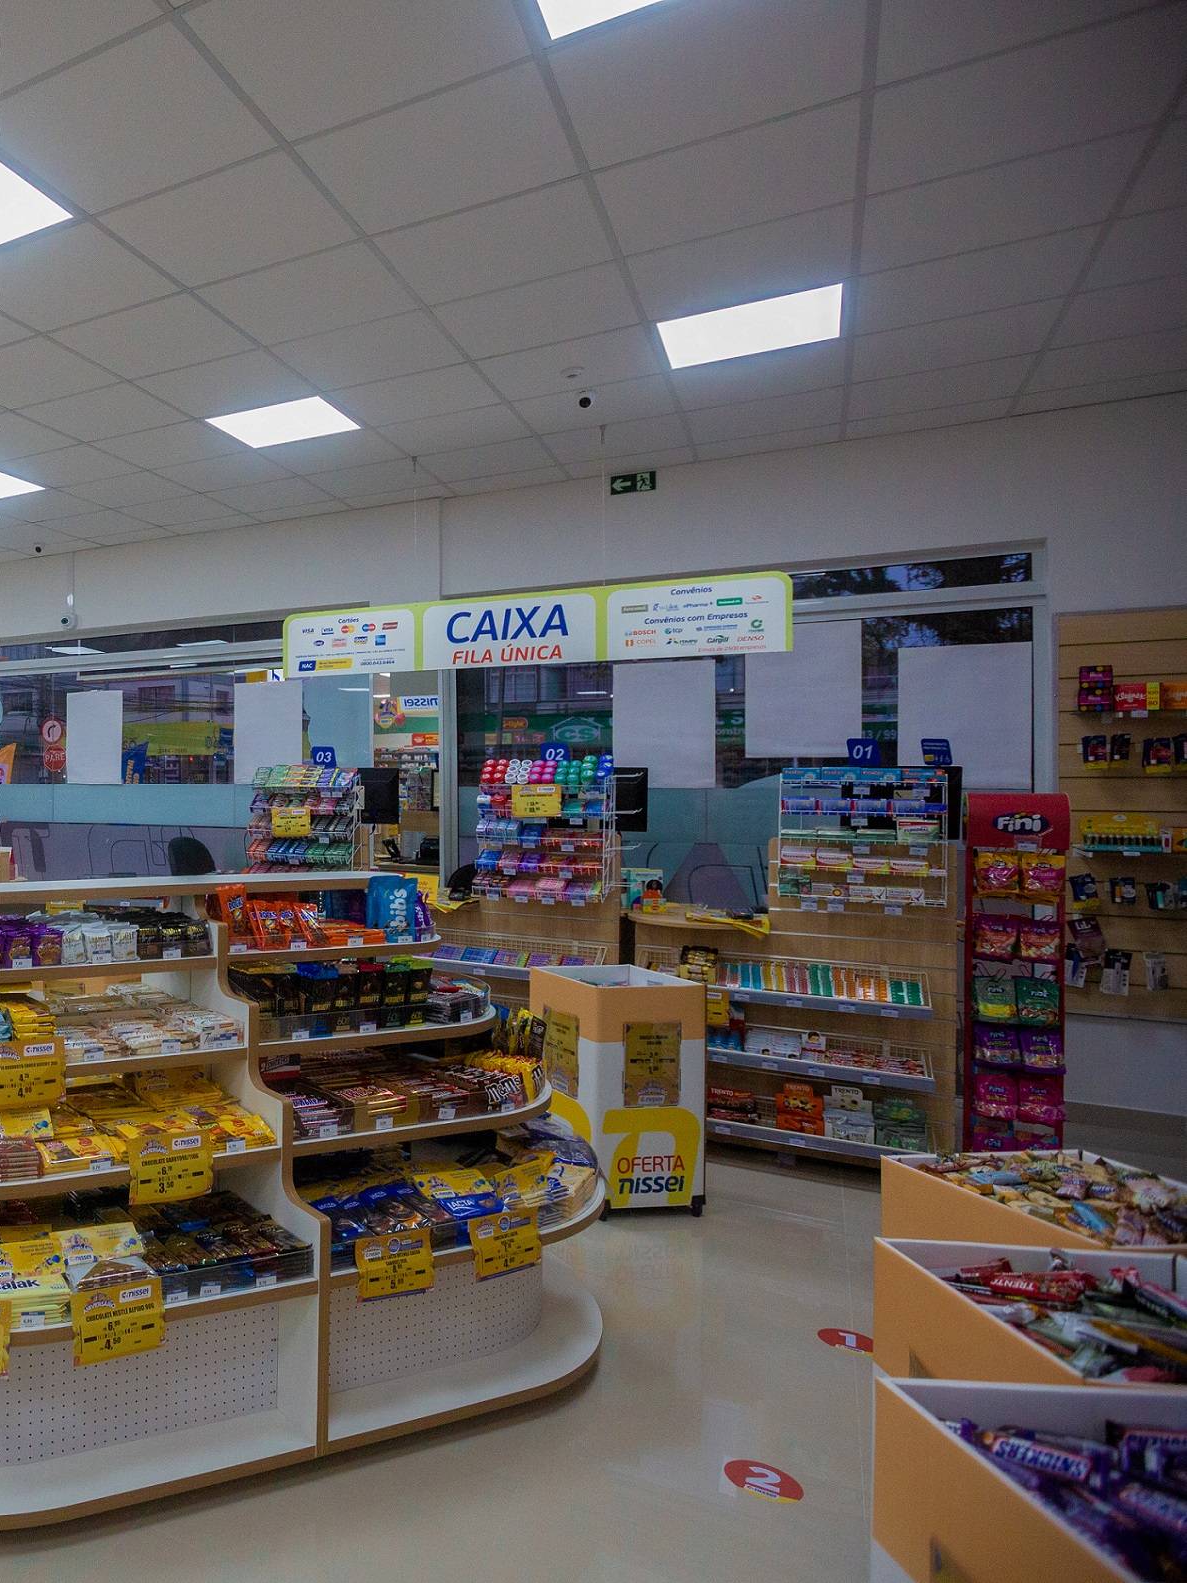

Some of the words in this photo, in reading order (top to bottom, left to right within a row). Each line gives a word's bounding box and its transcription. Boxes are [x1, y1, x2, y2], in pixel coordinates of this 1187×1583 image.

[670, 586, 713, 596] Convênios
[446, 604, 569, 643] CAIXA
[643, 616, 686, 625] Convênios
[687, 614, 705, 622] com
[707, 611, 748, 622] Empresas
[453, 649, 493, 664] FILA
[500, 643, 563, 662] ÚNICA
[316, 752, 332, 762] 03
[546, 749, 565, 760] 02
[853, 745, 873, 759] 01
[997, 814, 1041, 831] Fini
[617, 1154, 685, 1174] OFERTA
[619, 1175, 684, 1194] nissei
[447, 1198, 475, 1210] LACTA
[745, 1466, 781, 1493] 2
